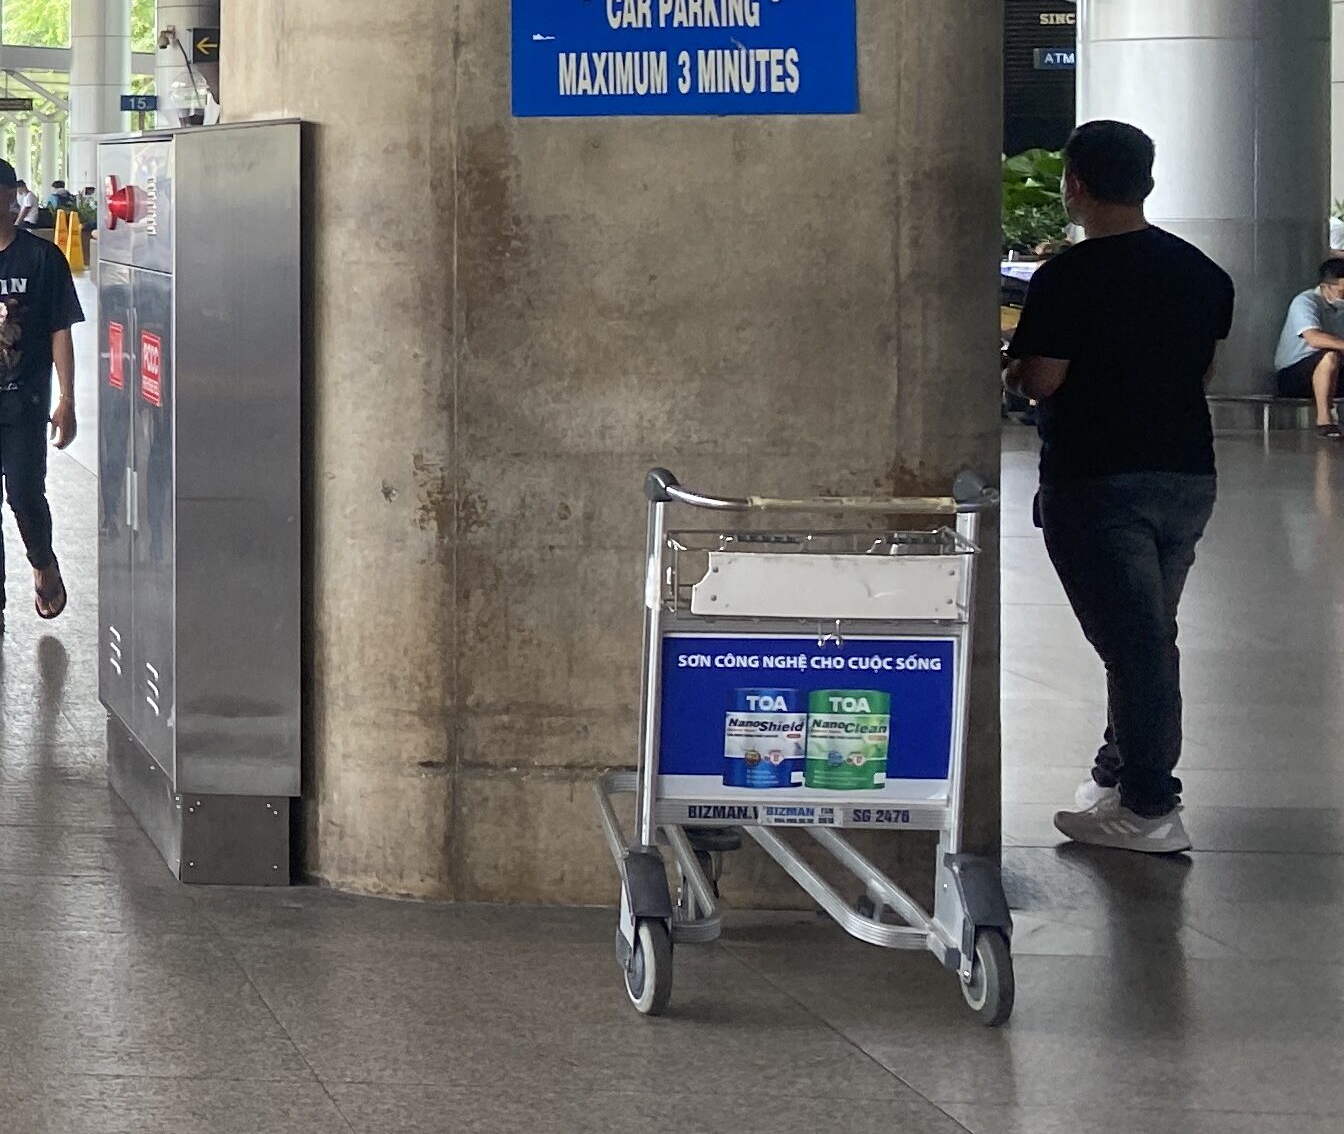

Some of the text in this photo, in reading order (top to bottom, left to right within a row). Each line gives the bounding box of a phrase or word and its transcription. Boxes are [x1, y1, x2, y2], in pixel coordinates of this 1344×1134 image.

[1044, 52, 1075, 64] ATM
[558, 47, 801, 96] MAXIMUM 3 MINUTES
[129, 97, 147, 110] 15
[677, 652, 942, 674] SƠN CÔNG NGHỆ CHO CUỘC SỐNG
[746, 694, 788, 712] TOA
[828, 696, 872, 714] TOA
[727, 718, 805, 732] NanoShield
[811, 718, 888, 734] NanoClean
[766, 806, 815, 817] BIZMAN
[852, 809, 872, 823] SG
